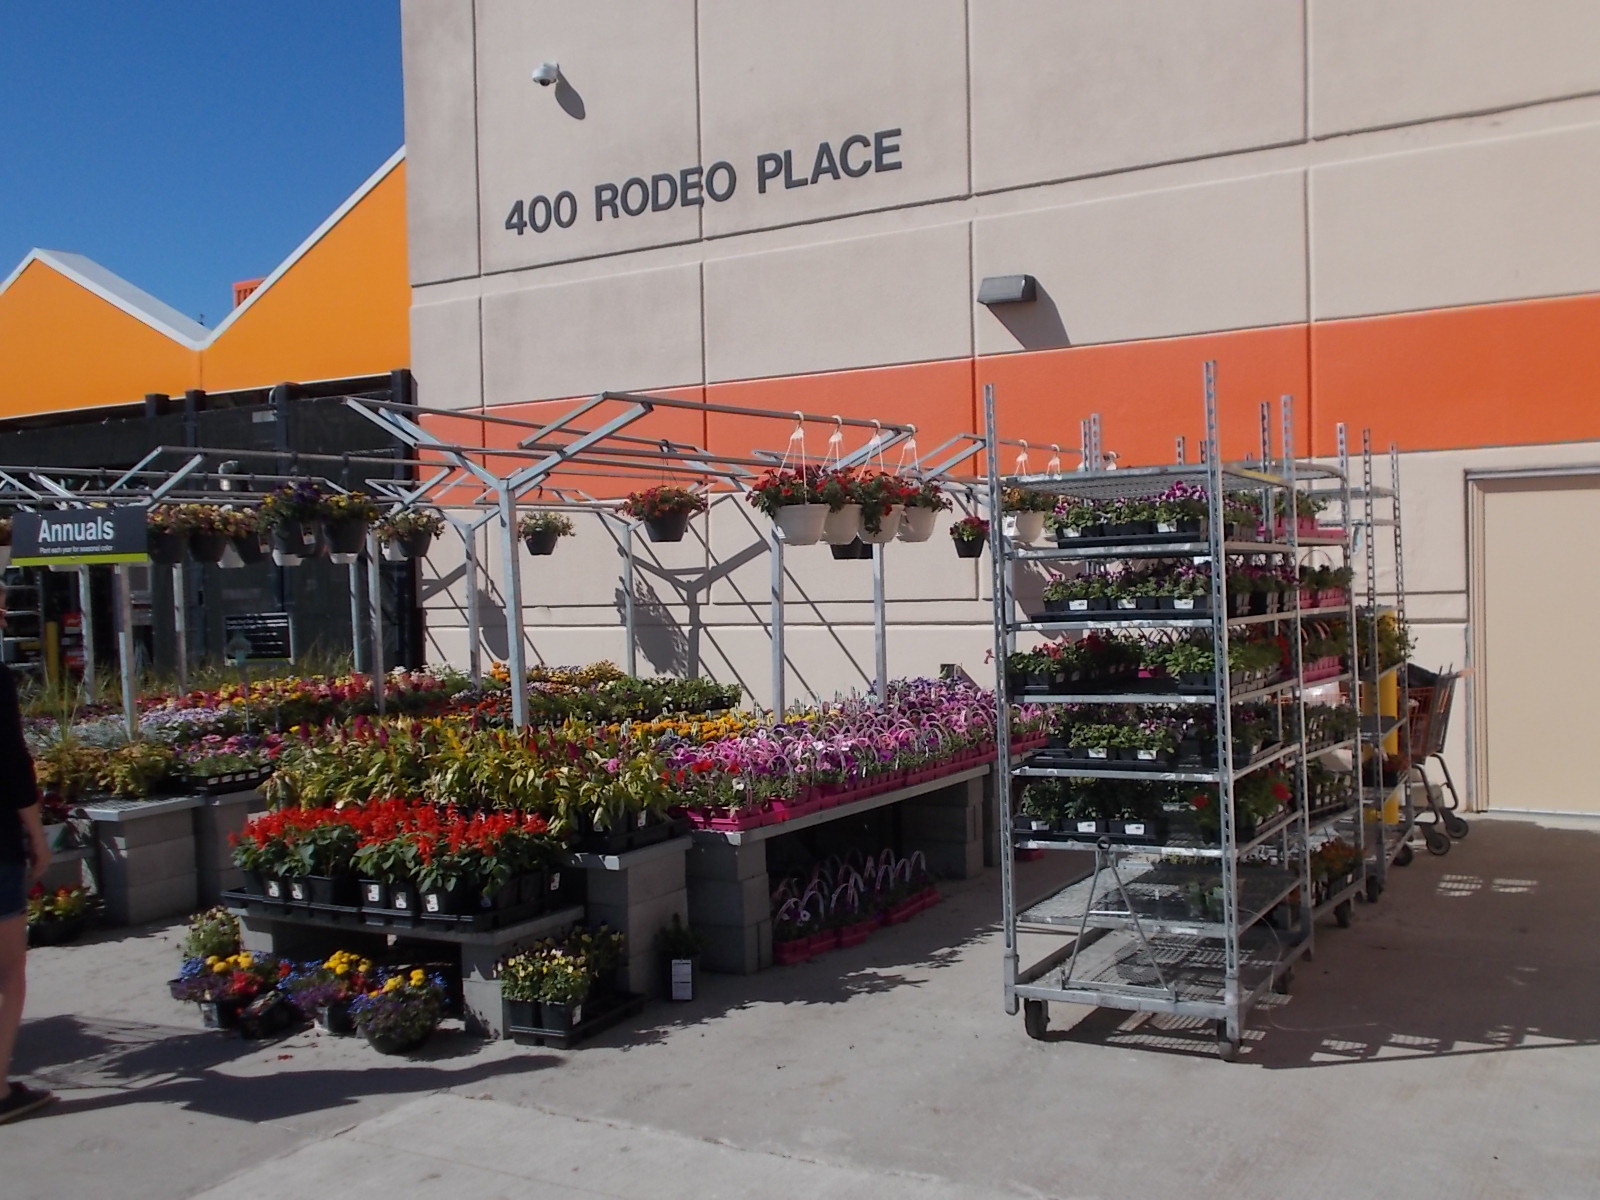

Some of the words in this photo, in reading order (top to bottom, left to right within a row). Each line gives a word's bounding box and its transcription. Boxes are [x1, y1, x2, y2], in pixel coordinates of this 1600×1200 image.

[504, 190, 577, 235] 400
[595, 161, 737, 222] RODEO
[757, 128, 902, 194] PLACE
[38, 516, 115, 542] Annuals
